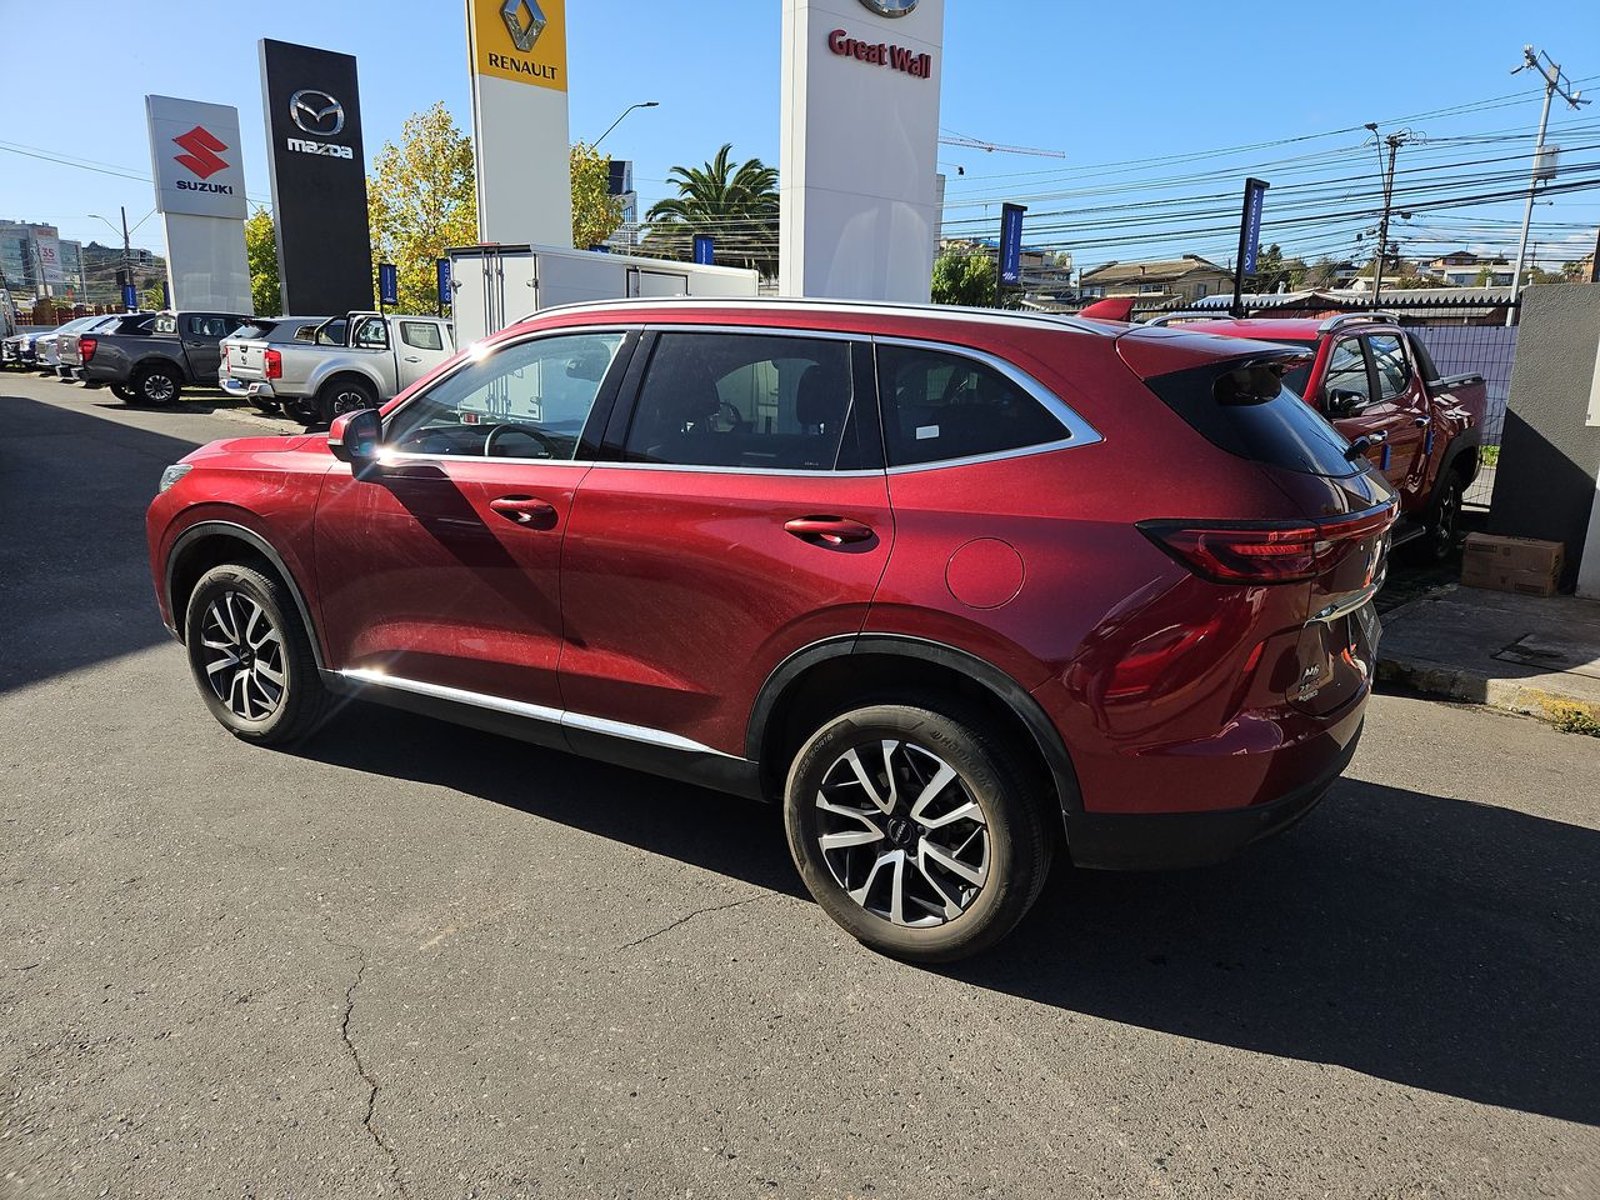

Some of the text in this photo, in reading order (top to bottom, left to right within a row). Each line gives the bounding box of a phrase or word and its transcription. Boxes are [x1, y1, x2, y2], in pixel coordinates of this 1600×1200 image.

[488, 52, 558, 80] RENAULT
[828, 29, 931, 79] Great Wall
[176, 180, 233, 195] SUZUKI
